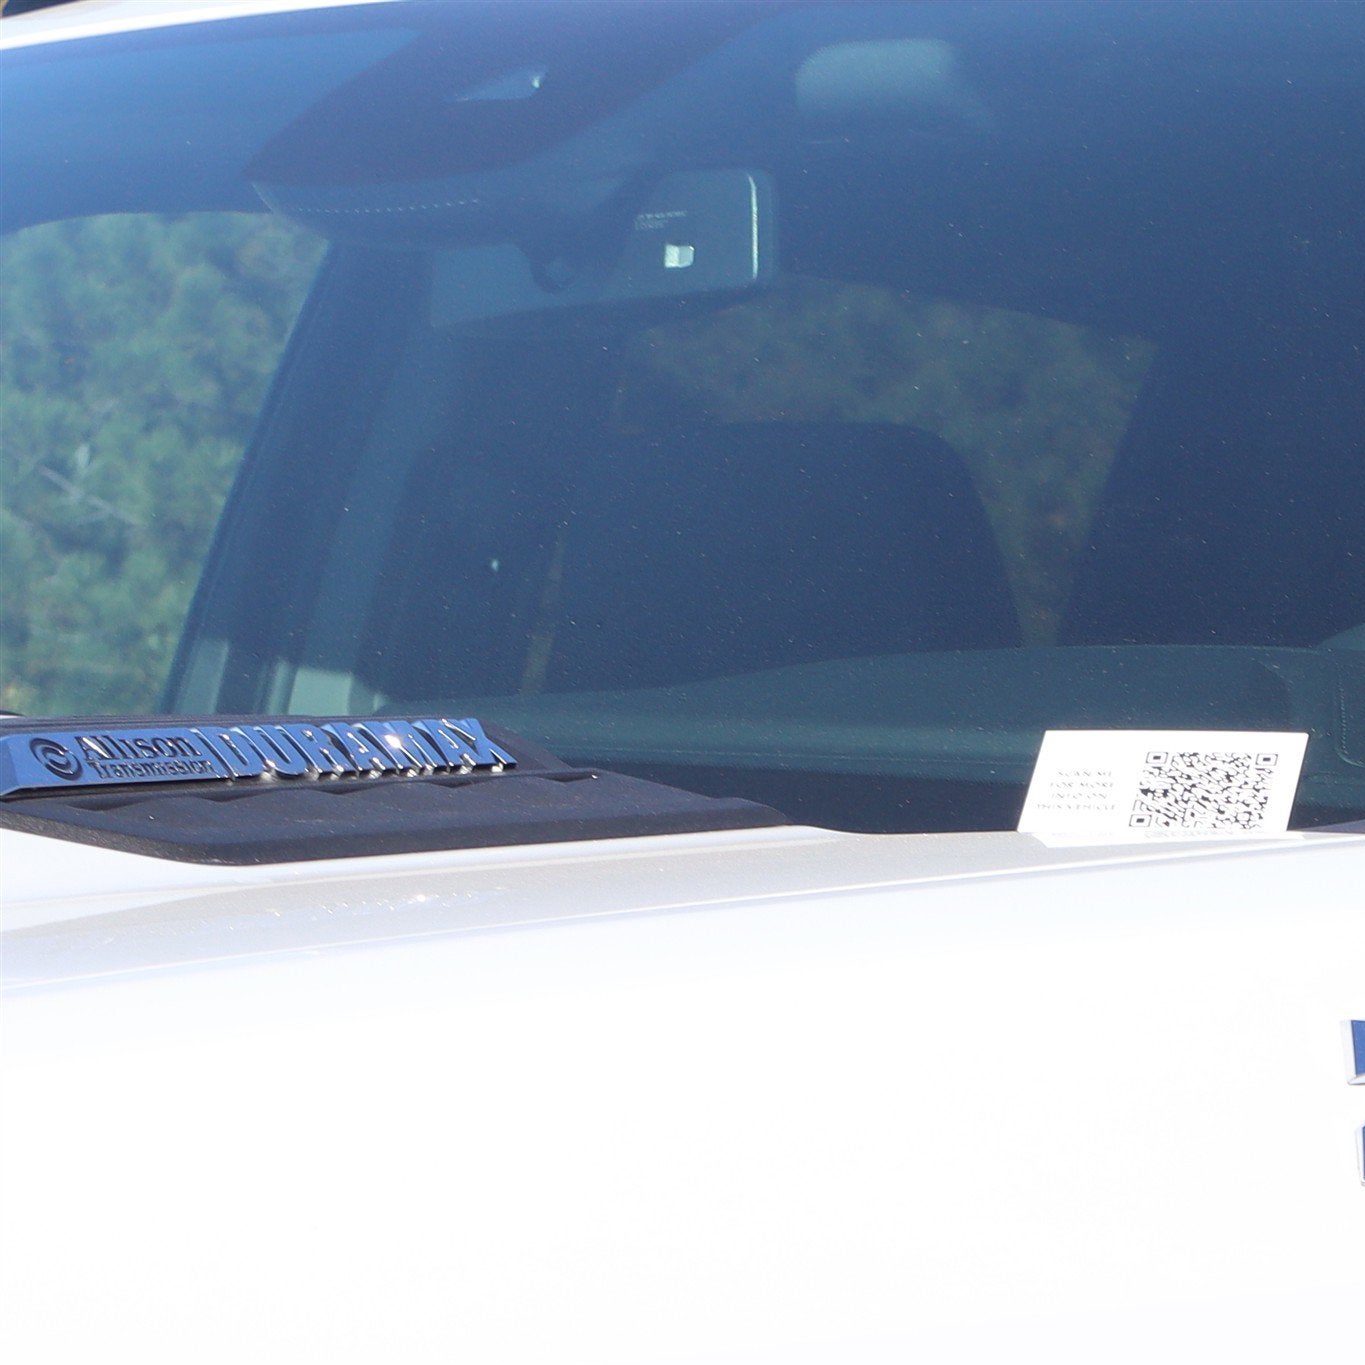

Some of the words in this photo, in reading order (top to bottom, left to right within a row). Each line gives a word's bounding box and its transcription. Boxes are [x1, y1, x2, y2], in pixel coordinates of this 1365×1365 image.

[75, 735, 202, 761] Allison
[187, 717, 518, 780] DURAMAX
[87, 759, 218, 779] Transmission
